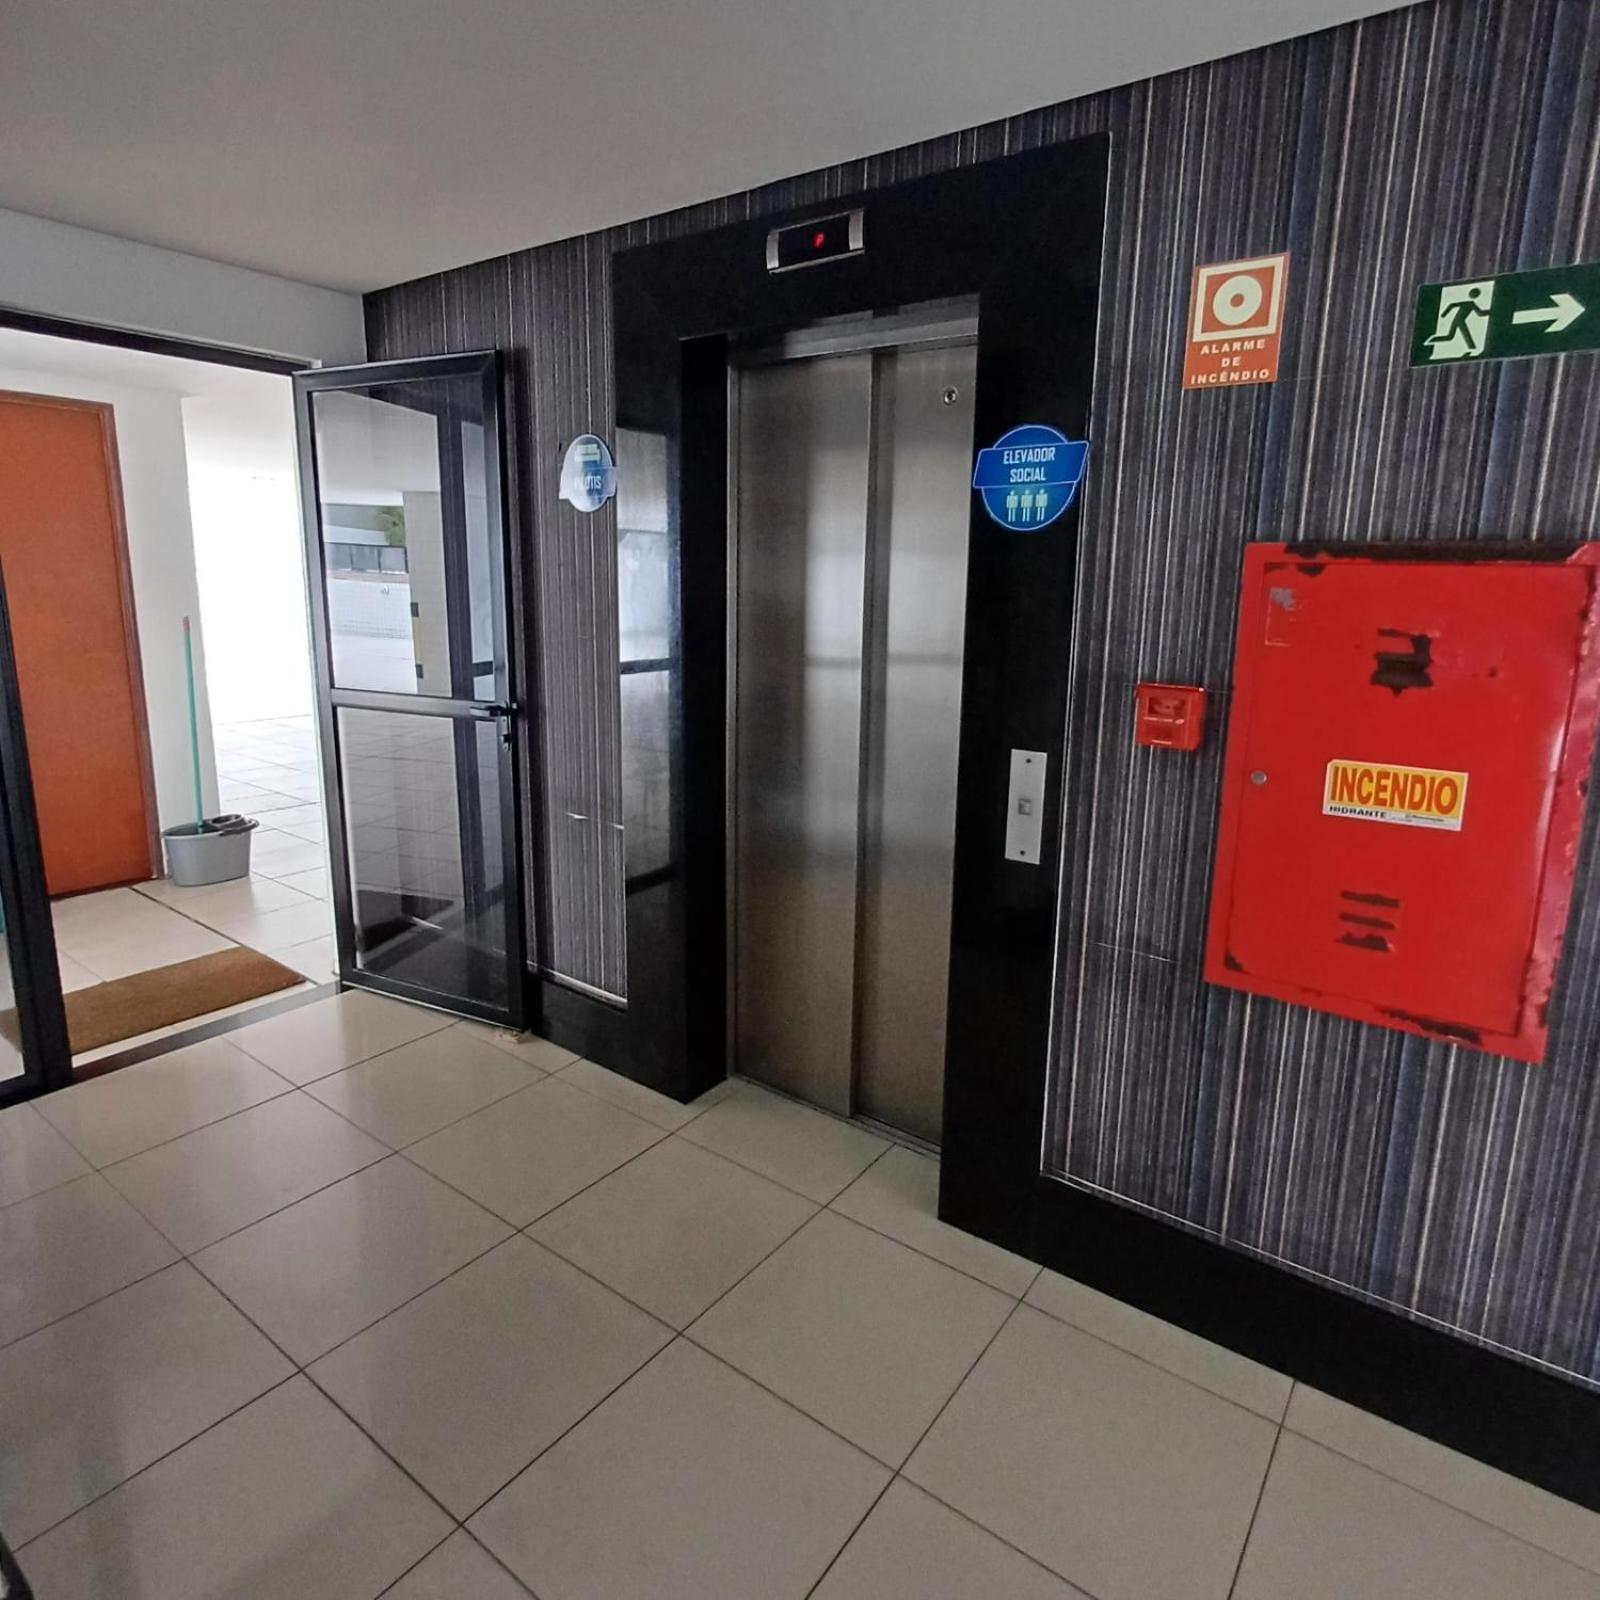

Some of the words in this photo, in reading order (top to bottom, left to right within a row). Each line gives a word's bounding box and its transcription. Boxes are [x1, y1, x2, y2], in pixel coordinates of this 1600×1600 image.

[1200, 339, 1266, 355] ALARME
[1221, 356, 1242, 368] DE
[1191, 369, 1270, 385] INCÊNDIO
[1003, 447, 1056, 465] ELEVADOR
[1010, 467, 1047, 483] SOCIAL
[1329, 805, 1387, 819] HIDRANTE
